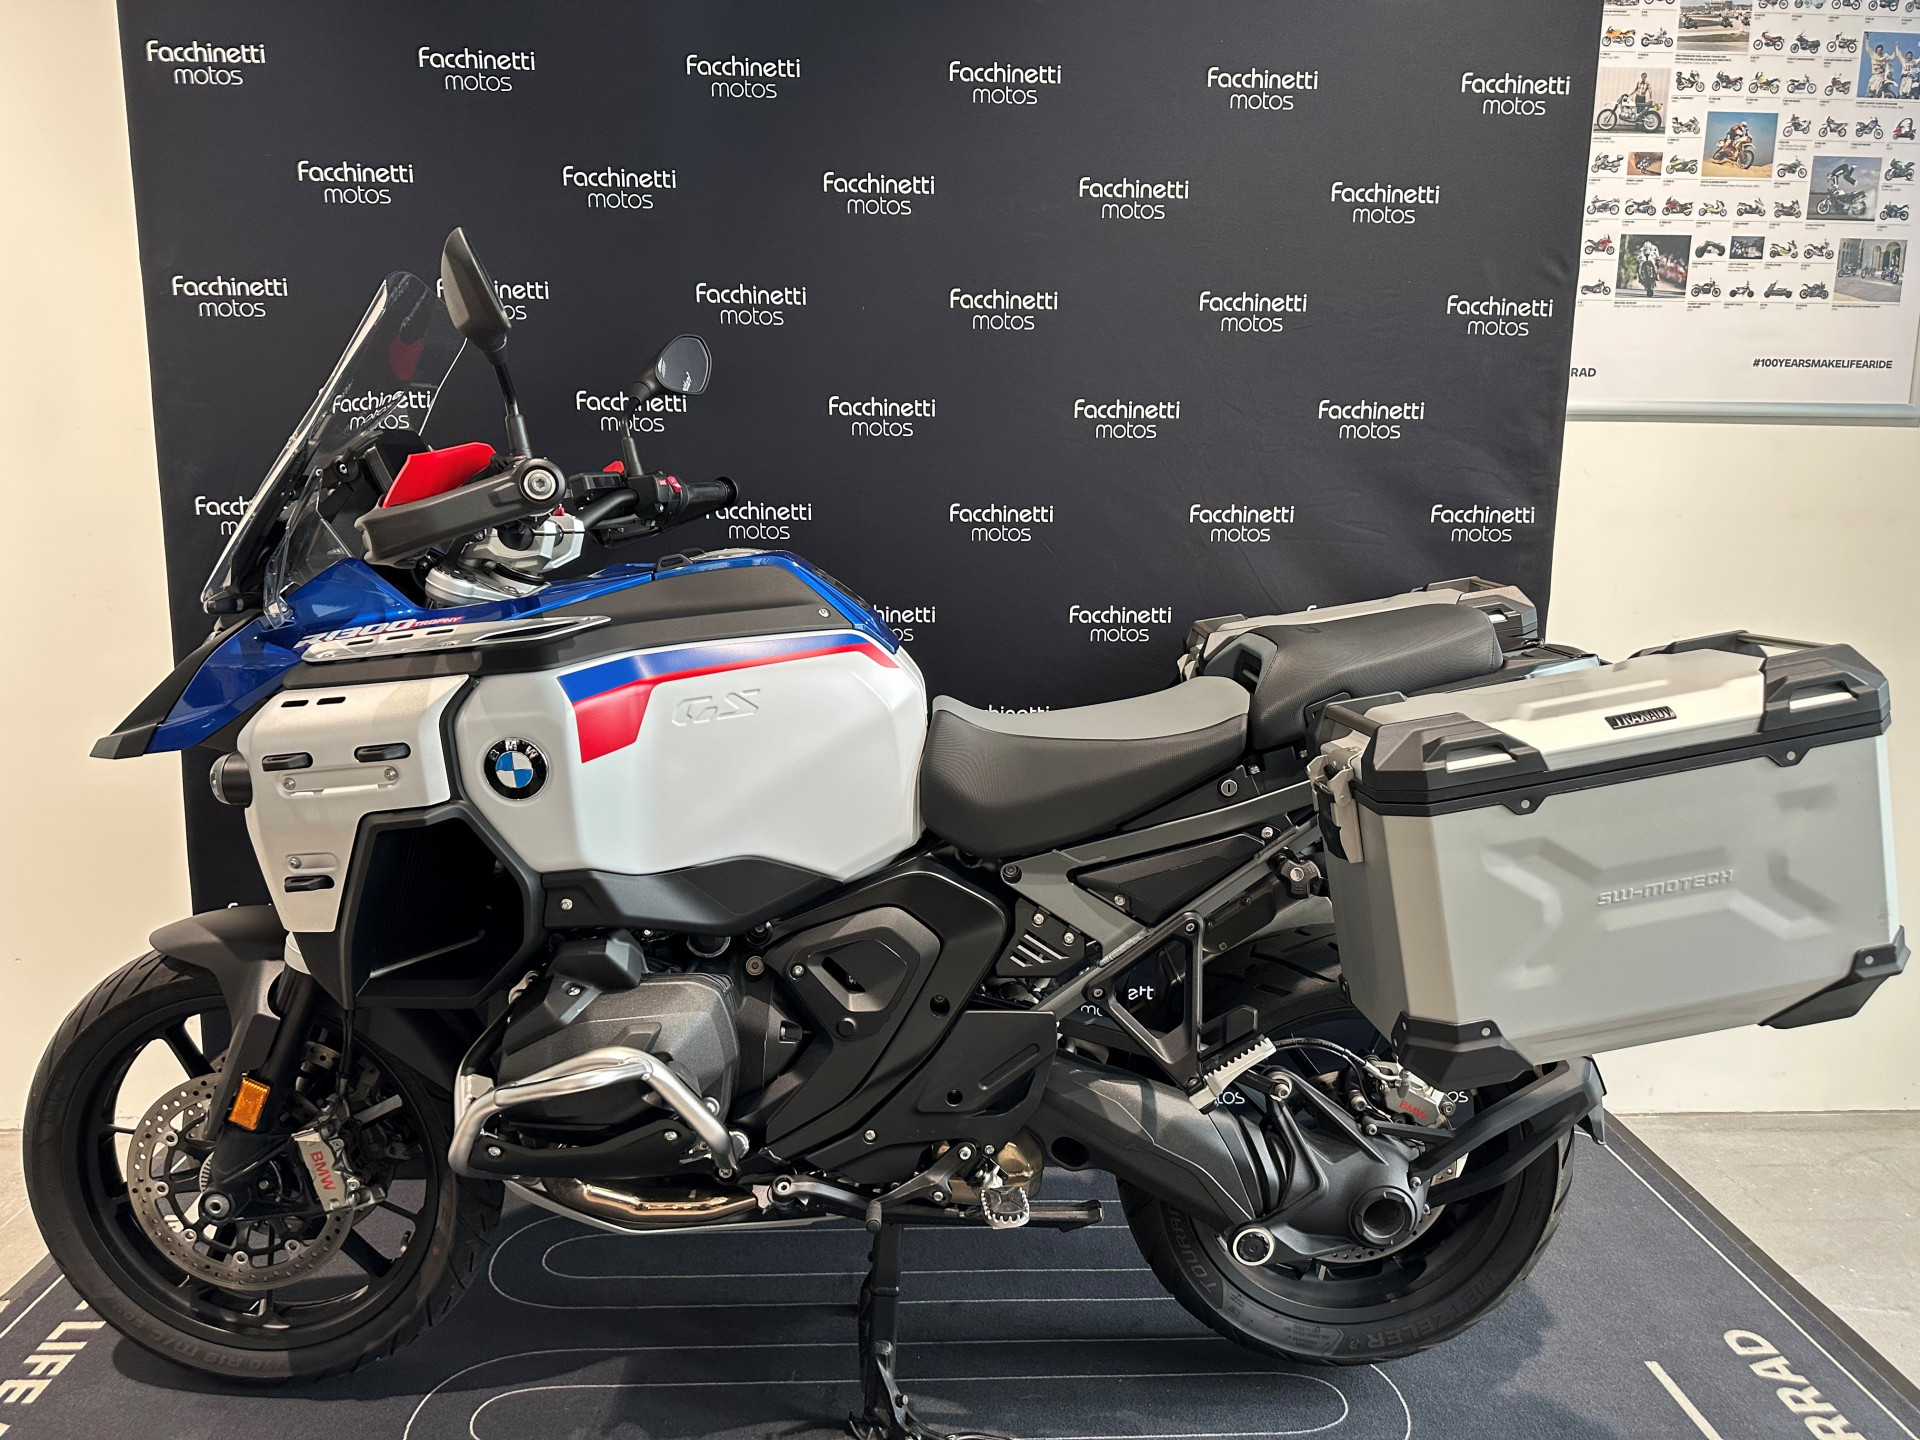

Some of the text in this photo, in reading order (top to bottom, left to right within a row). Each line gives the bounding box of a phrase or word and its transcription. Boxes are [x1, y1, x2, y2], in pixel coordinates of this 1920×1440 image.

[145, 40, 265, 63] Facchinetti
[418, 47, 535, 70] Facchinetti
[173, 66, 243, 85] motos
[686, 55, 800, 77] Facchinetti
[949, 61, 1061, 84] Facchinetti
[444, 73, 512, 91] motos
[1207, 67, 1318, 89] Facchinetti
[1461, 72, 1570, 95] Facchinetti
[711, 80, 777, 98] motos
[972, 86, 1037, 104] motos
[1229, 92, 1294, 110] motos
[1482, 97, 1545, 115] motos
[297, 161, 413, 183] Facchinetti
[562, 166, 676, 188] Facchinetti
[823, 172, 934, 194] Facchinetti
[1078, 177, 1189, 199] Facchinetti
[1330, 182, 1440, 204] Facchinetti
[323, 186, 391, 204] motos
[587, 191, 653, 209] motos
[847, 197, 911, 215] motos
[1101, 201, 1165, 219] motos
[1352, 206, 1415, 224] motos
[171, 276, 287, 299] Facchinetti
[436, 278, 549, 300] Finetti
[695, 283, 806, 305] Facchinetti
[198, 299, 266, 317] motos
[949, 288, 1058, 310] Facchinetti
[1199, 291, 1307, 312] Facchinetti
[1446, 295, 1553, 317] Facchinetti
[720, 307, 784, 325] motos
[972, 312, 1034, 330] motos
[1220, 314, 1283, 332] motos
[1467, 319, 1528, 336] motos
[1752, 357, 1893, 369] #100YEARSMAKELIFEARIDE
[828, 396, 935, 417] Facchinetti
[1073, 399, 1180, 419] Facchinetti
[1318, 400, 1424, 421] Facchinetti
[851, 419, 913, 436] motos
[1095, 421, 1156, 438] motos
[1338, 422, 1400, 439] motos
[705, 501, 812, 521] acchinetti
[949, 503, 1053, 523] Facchinetti
[1189, 504, 1294, 524] Facchinetti
[1430, 504, 1535, 524] Facchinetti
[728, 523, 790, 540] motos
[971, 525, 1031, 542] motos
[1210, 526, 1270, 543] motos
[1450, 526, 1512, 543] motos
[414, 615, 464, 627] TROPHY
[1069, 605, 1171, 624] Facchinetti
[1090, 626, 1149, 642] motos
[671, 688, 761, 726] GS
[488, 738, 538, 762] BMW
[1596, 868, 1734, 906] SW-MOTECH
[1399, 1100, 1428, 1119] BMW
[310, 1150, 336, 1191] BMW
[0, 1320, 106, 1404] LIFE
